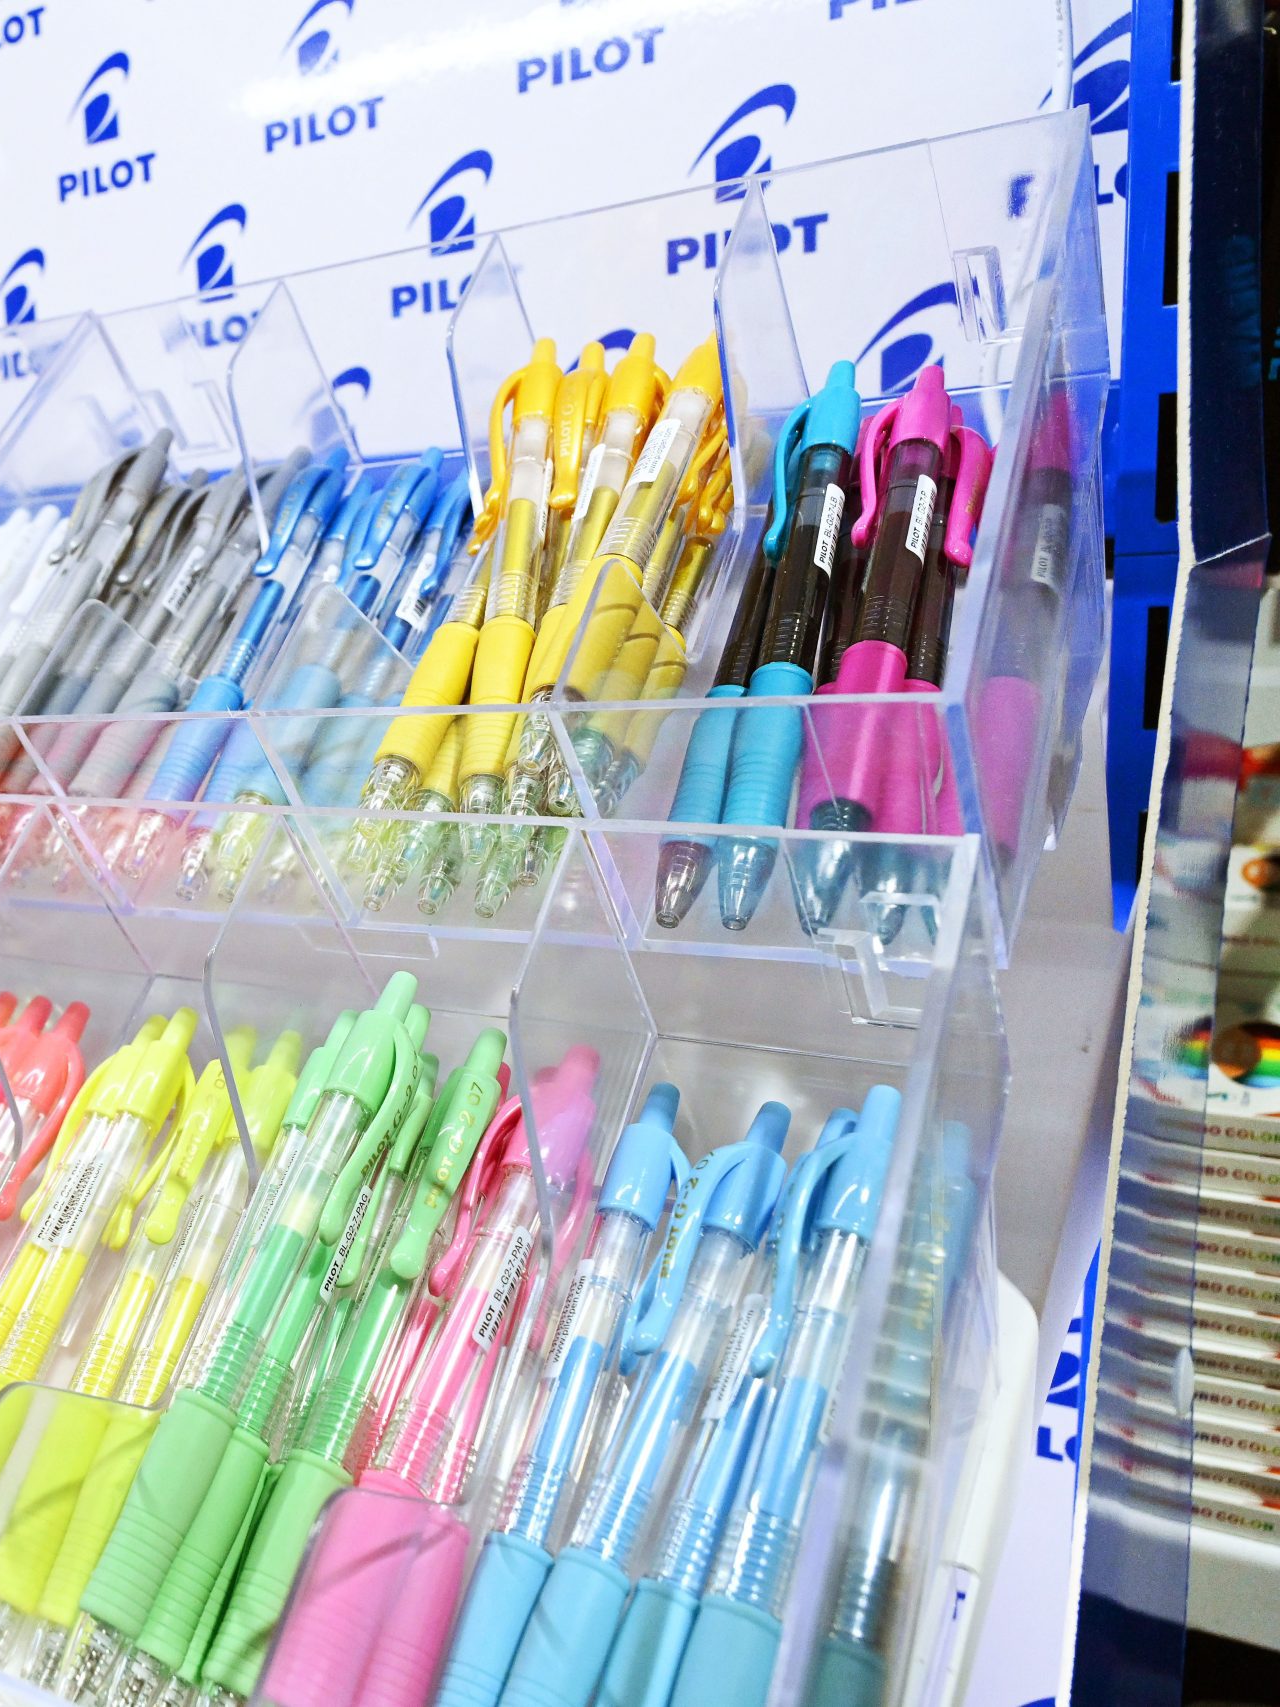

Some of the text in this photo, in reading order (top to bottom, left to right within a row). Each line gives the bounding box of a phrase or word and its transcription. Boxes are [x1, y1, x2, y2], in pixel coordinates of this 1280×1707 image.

[518, 27, 664, 94] PILOT
[264, 97, 384, 154] PILOT
[59, 153, 156, 202] PILOT
[666, 212, 829, 275] PIOT
[391, 274, 472, 318] PIL
[911, 527, 921, 549] PILOT
[361, 1132, 391, 1177] PILOT
[324, 1193, 370, 1292] PILOT BL-G2-7-PAG
[659, 1225, 680, 1279] PILOT
[478, 1236, 525, 1338] PILOT BL-G2-7-PAP
[552, 1274, 587, 1363] www.pilotpen.com
